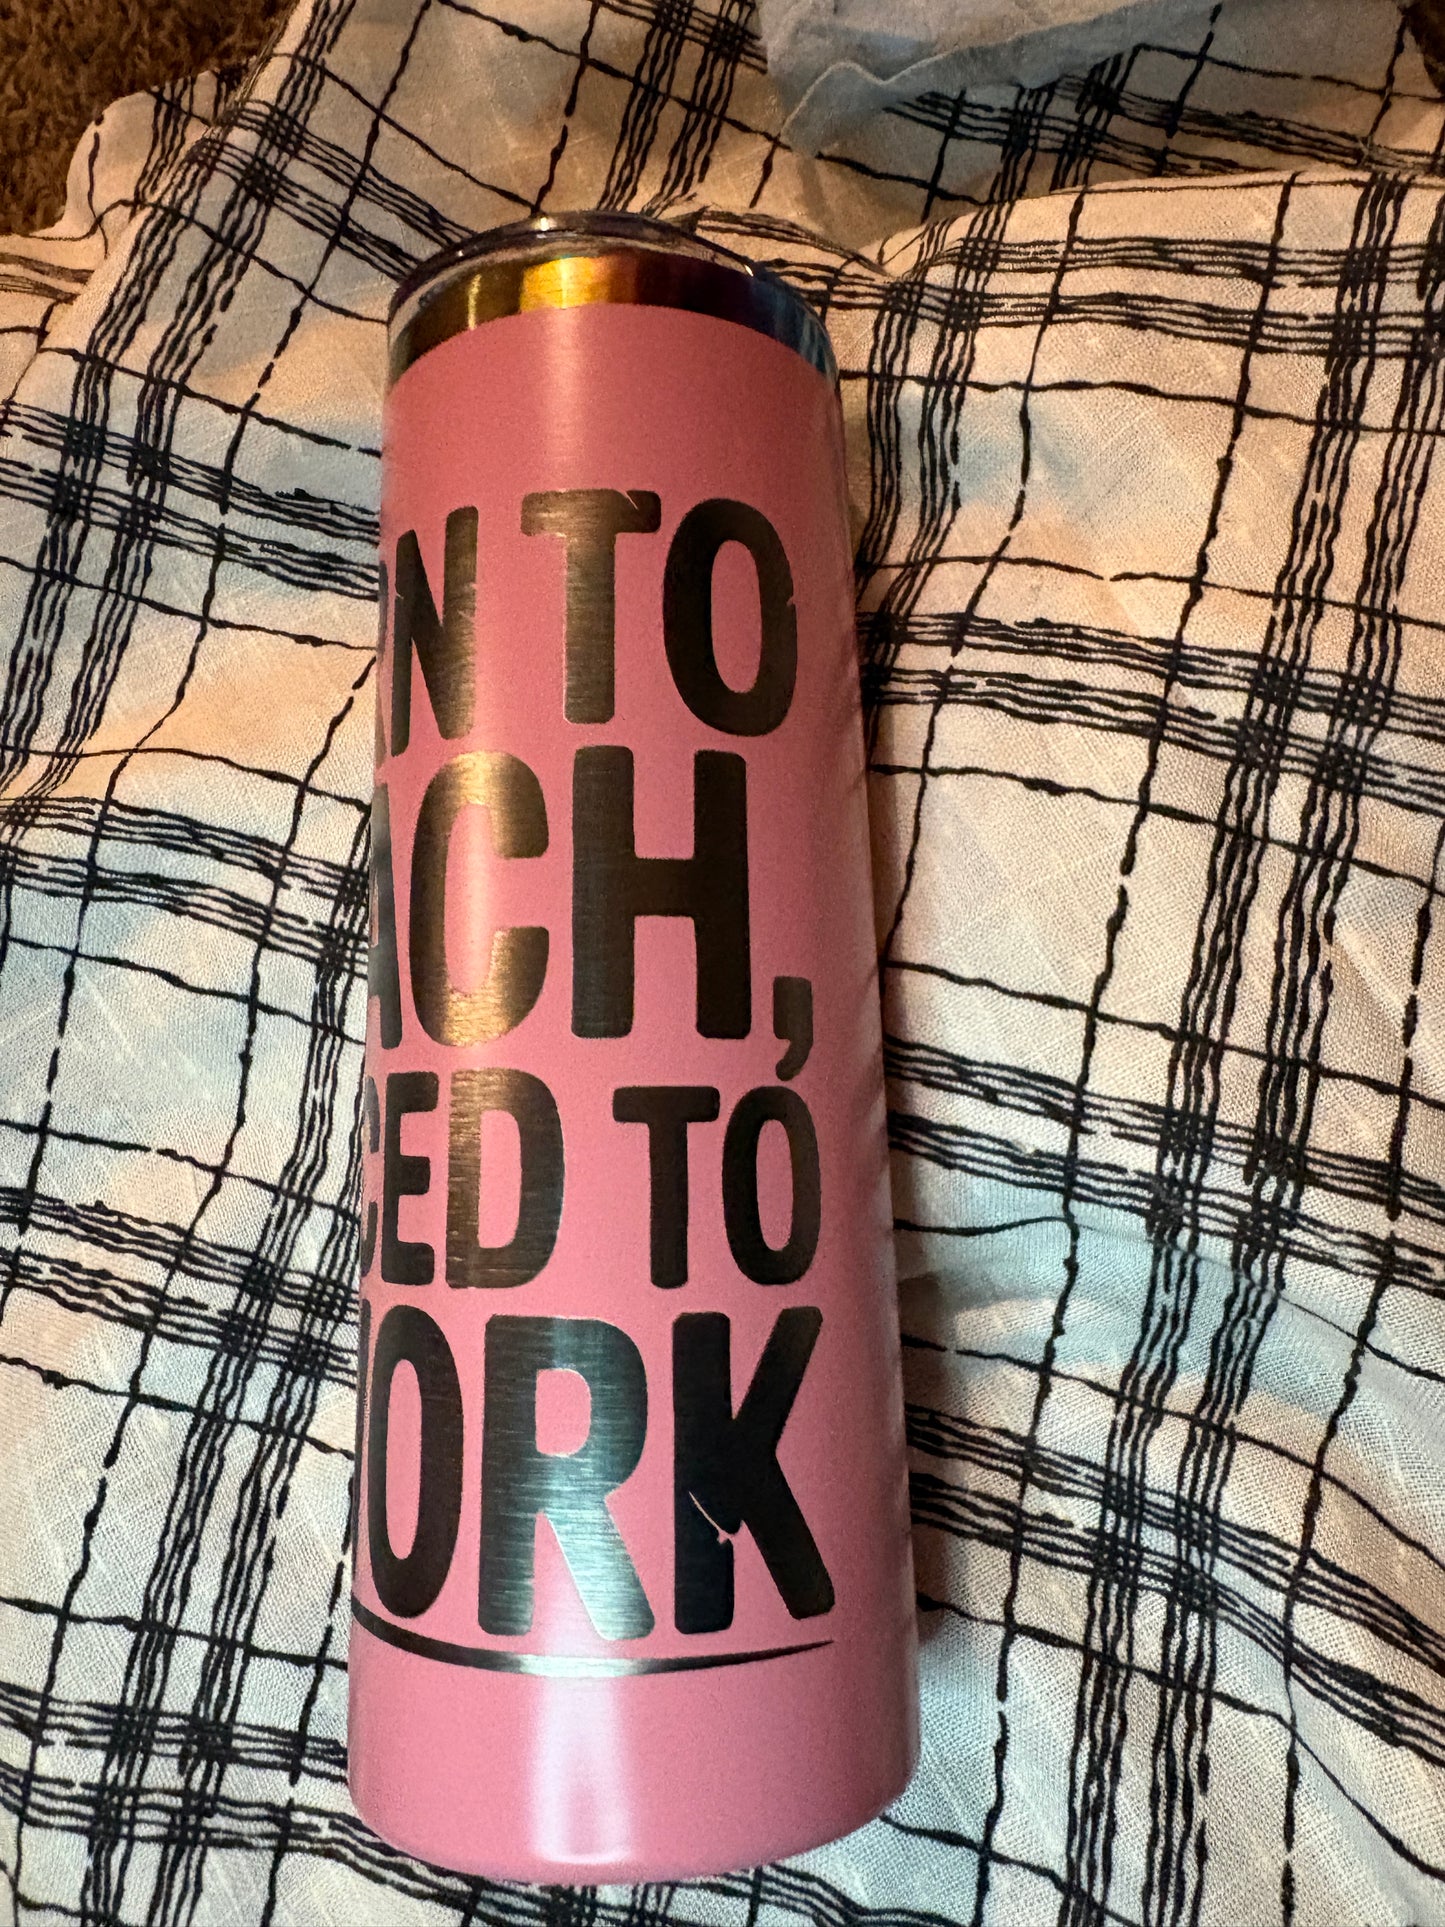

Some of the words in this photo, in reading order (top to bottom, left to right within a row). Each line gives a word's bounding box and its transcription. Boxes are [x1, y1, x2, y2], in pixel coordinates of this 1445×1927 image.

[375, 506, 479, 769] N
[521, 488, 798, 737] TO
[612, 1085, 821, 1289] TO
[352, 1298, 836, 1640] ORK
